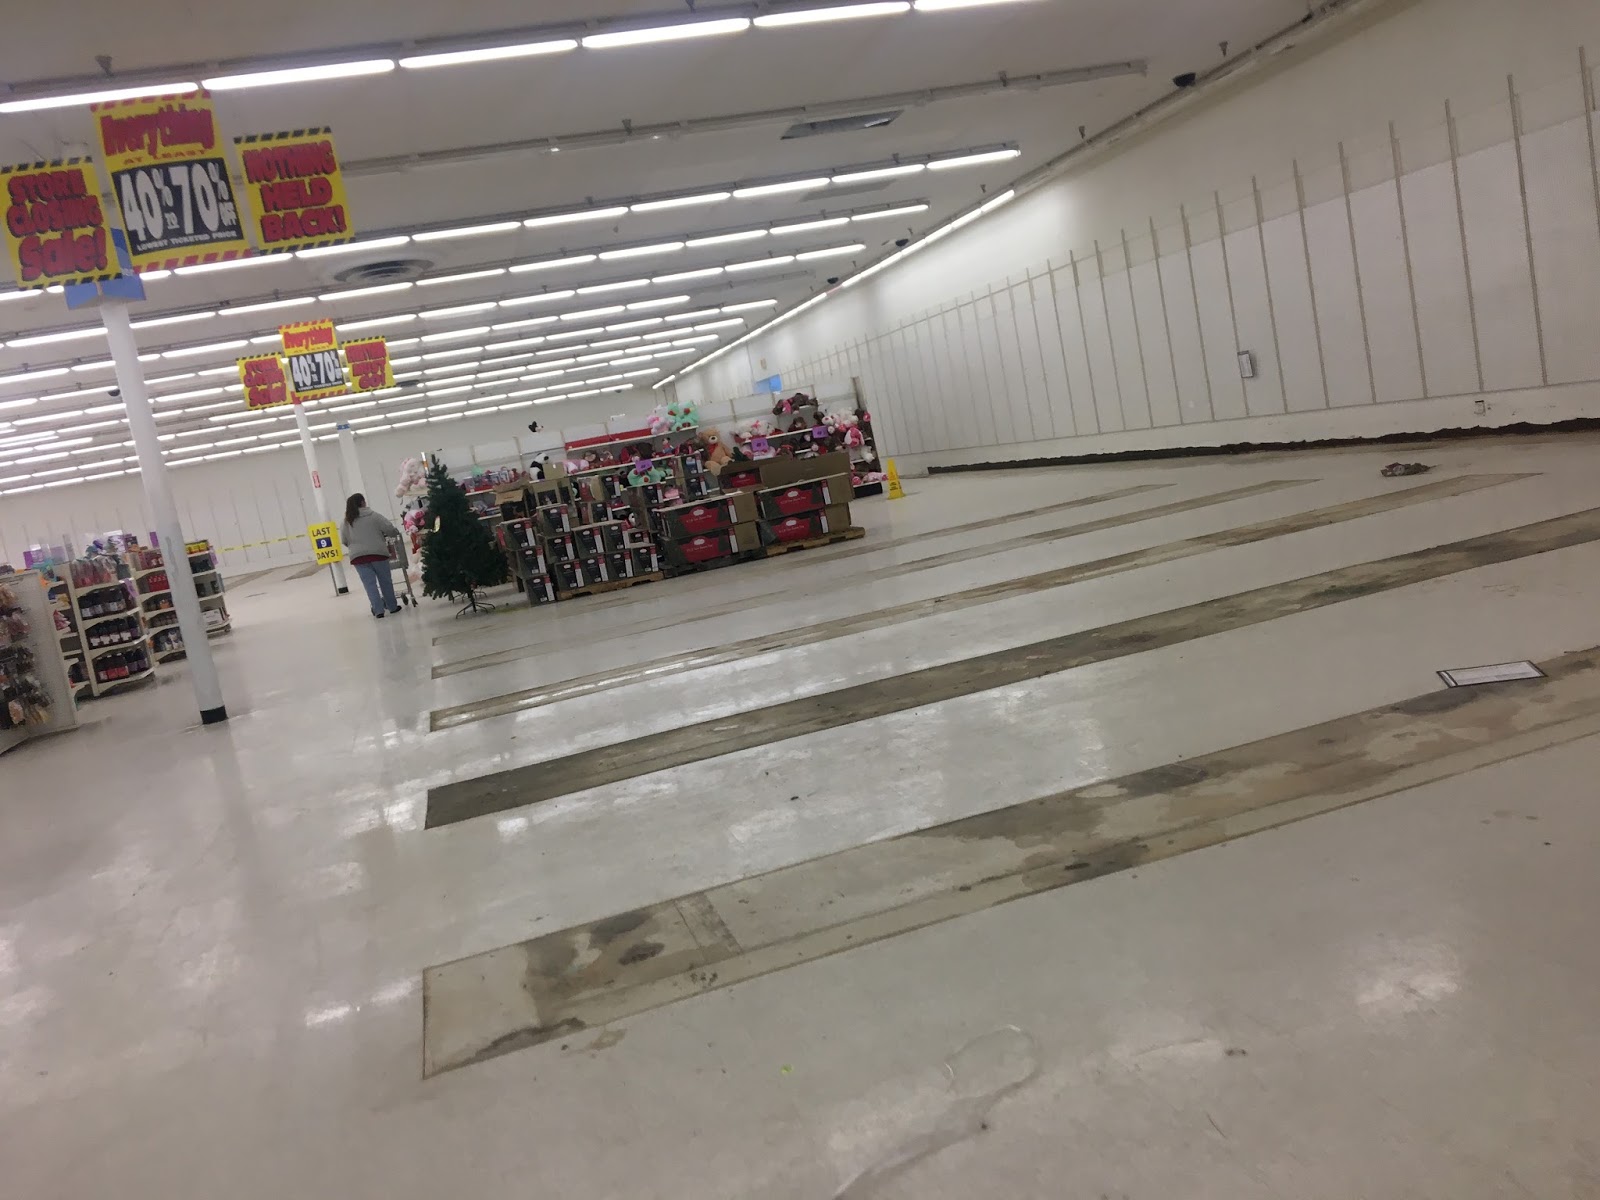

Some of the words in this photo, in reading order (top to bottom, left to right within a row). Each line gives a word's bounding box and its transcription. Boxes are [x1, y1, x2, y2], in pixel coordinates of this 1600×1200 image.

[101, 104, 215, 156] Everything
[123, 156, 143, 165] AT
[152, 150, 206, 160] LEAST
[242, 140, 337, 184] NOTHING
[8, 168, 87, 206] STORE
[260, 177, 333, 213] HELD
[7, 195, 104, 238] CLOSING
[218, 201, 238, 227] OFF
[260, 204, 347, 243] BACK!
[212, 230, 238, 239] PRICE
[19, 226, 108, 281] Sale!
[311, 527, 331, 537] LAST
[320, 539, 327, 548] 9
[316, 549, 339, 560] DAYS!
